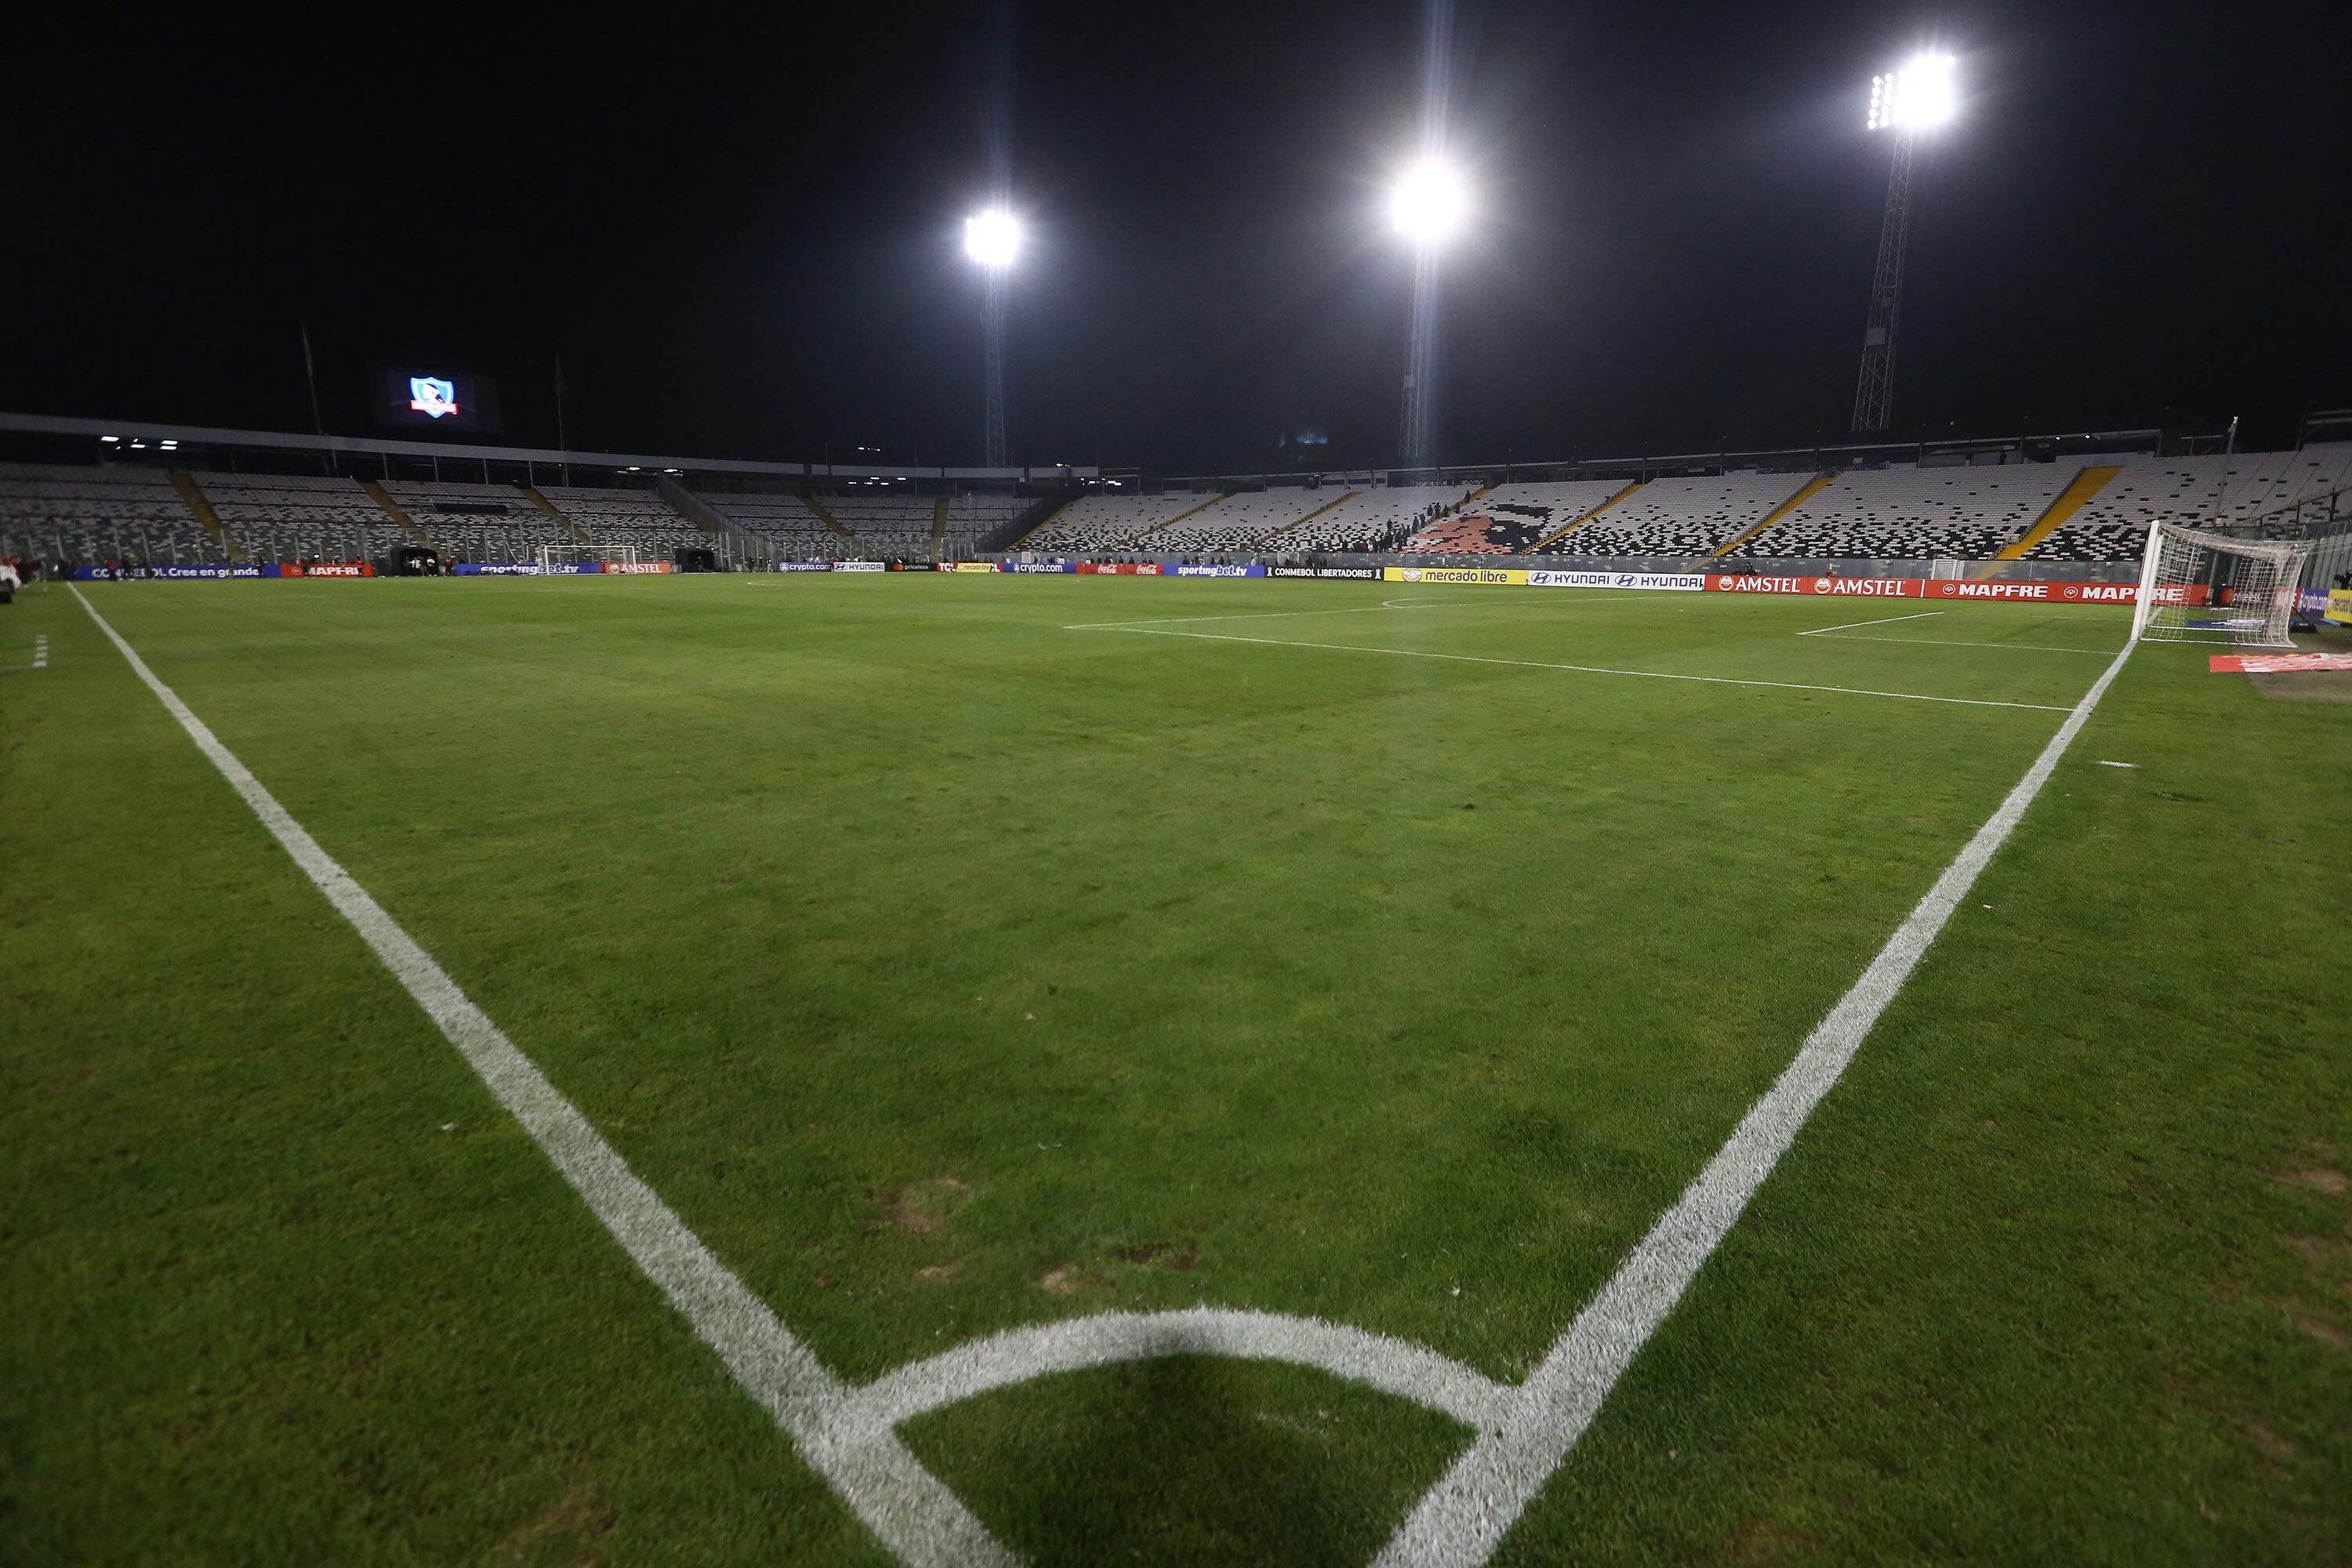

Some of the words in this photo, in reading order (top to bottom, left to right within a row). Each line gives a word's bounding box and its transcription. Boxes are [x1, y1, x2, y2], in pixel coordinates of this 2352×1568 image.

[168, 568, 198, 577] Cree
[621, 563, 662, 574] AMSTEL
[1020, 563, 1062, 573] crypto.com
[1178, 564, 1247, 577] sportingbet.tv
[1275, 567, 1316, 577] CONMEBOL
[1318, 568, 1372, 578] LIBERTADORES
[1425, 571, 1478, 582] mercado
[1480, 572, 1507, 583] libre
[1555, 575, 1610, 585] HYUNDAI
[1641, 577, 1702, 588] HYUNDAI
[1734, 577, 1801, 593] AMSTEL
[1832, 579, 1906, 596] AMSTEL
[1958, 584, 2049, 597] MAPFRE
